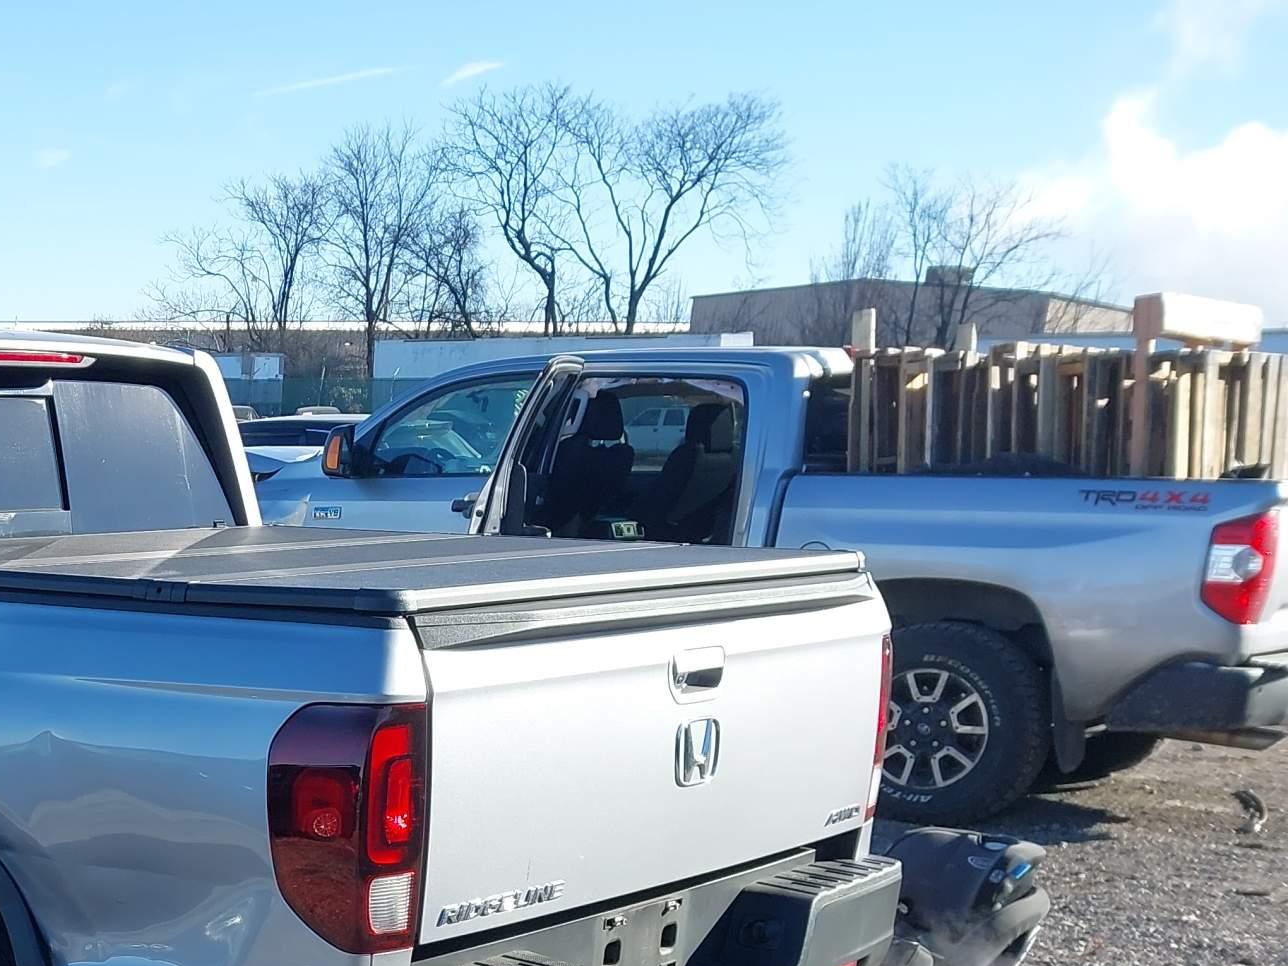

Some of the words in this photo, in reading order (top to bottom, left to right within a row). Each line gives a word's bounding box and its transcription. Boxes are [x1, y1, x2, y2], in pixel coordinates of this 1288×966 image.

[1079, 489, 1137, 506] TRD
[823, 805, 861, 828] AWD
[435, 880, 567, 928] RIDGELINE
